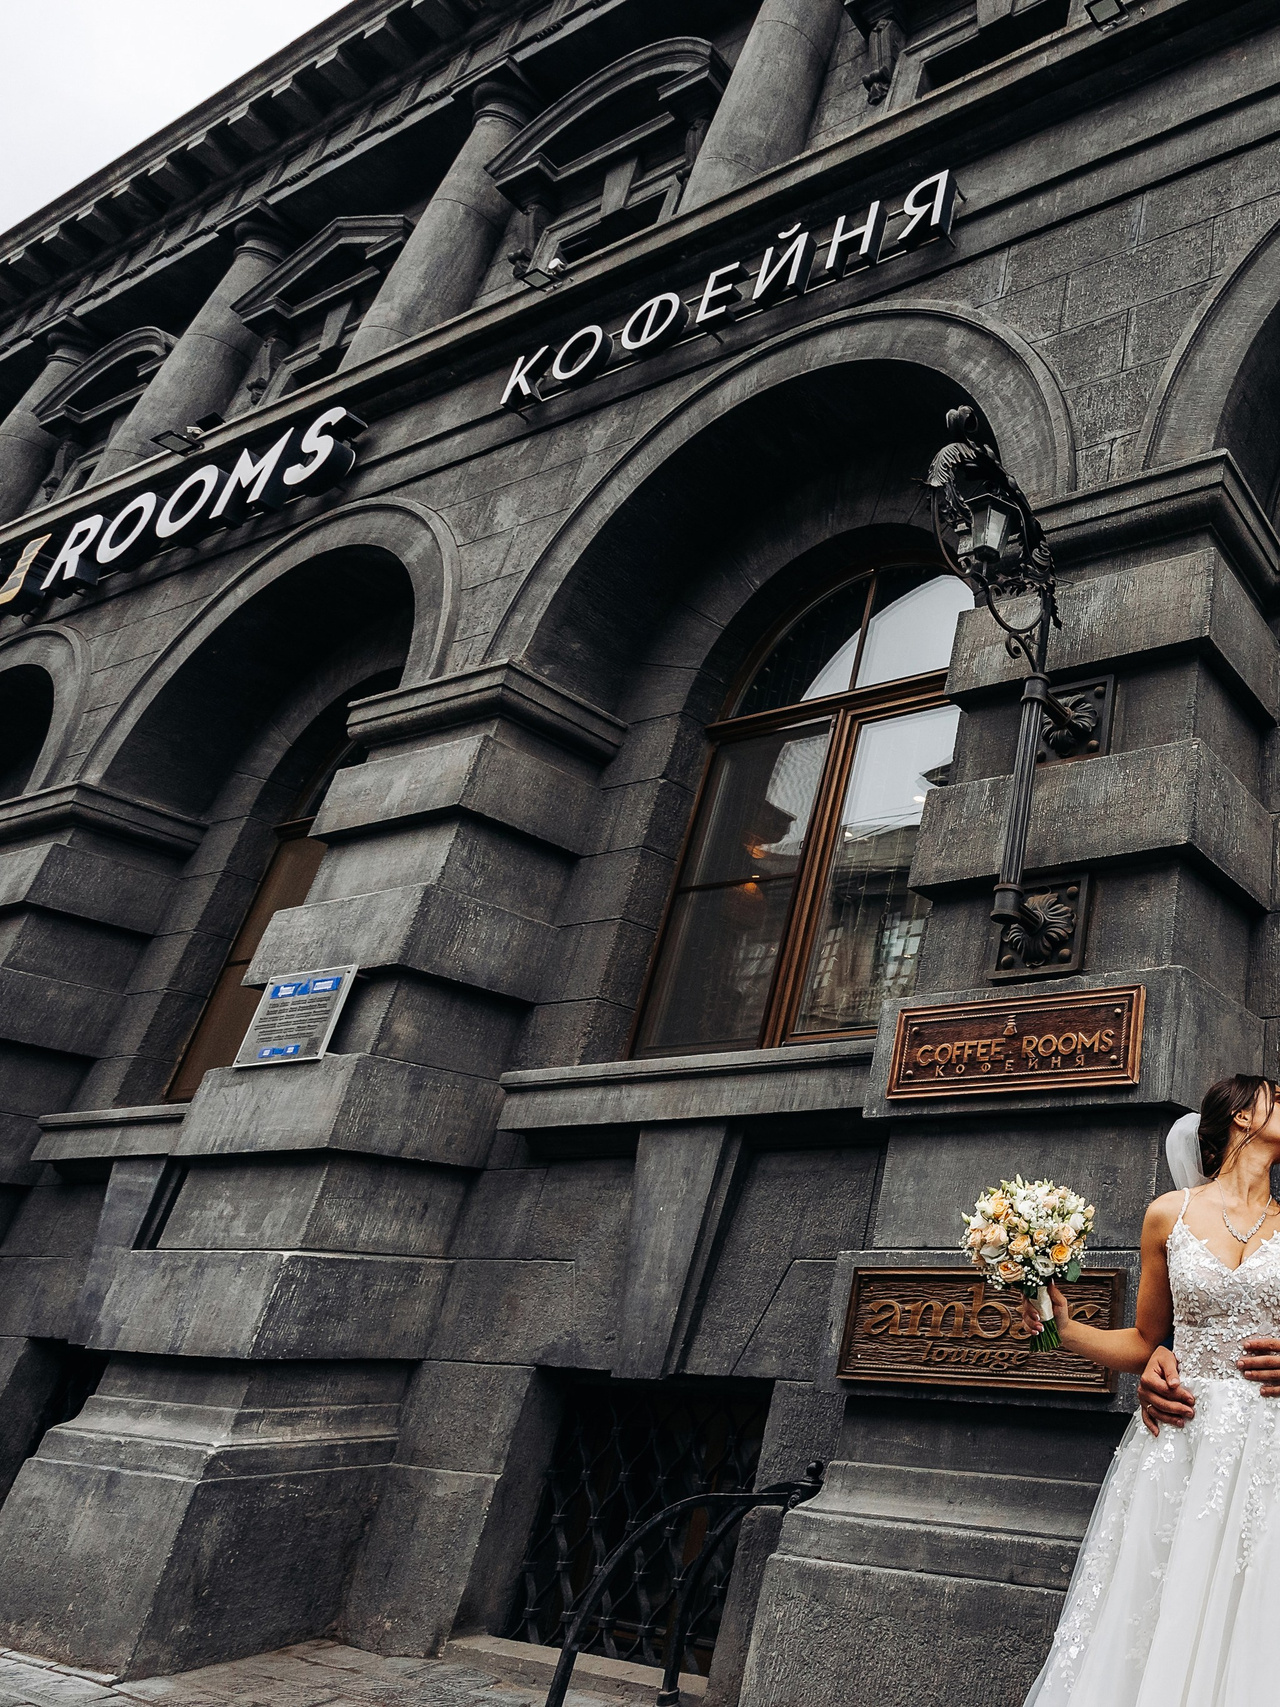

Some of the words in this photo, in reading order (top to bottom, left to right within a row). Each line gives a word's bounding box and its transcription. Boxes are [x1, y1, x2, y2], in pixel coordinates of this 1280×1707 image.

[499, 168, 951, 406] КОФЕЙНЯ
[39, 406, 350, 591] ROOMS
[916, 1037, 1007, 1067] COFFEE
[1020, 1028, 1116, 1060] ROOMS
[934, 1053, 1086, 1078] КОФЕЙНЯ
[921, 1340, 1030, 1371] lounge
